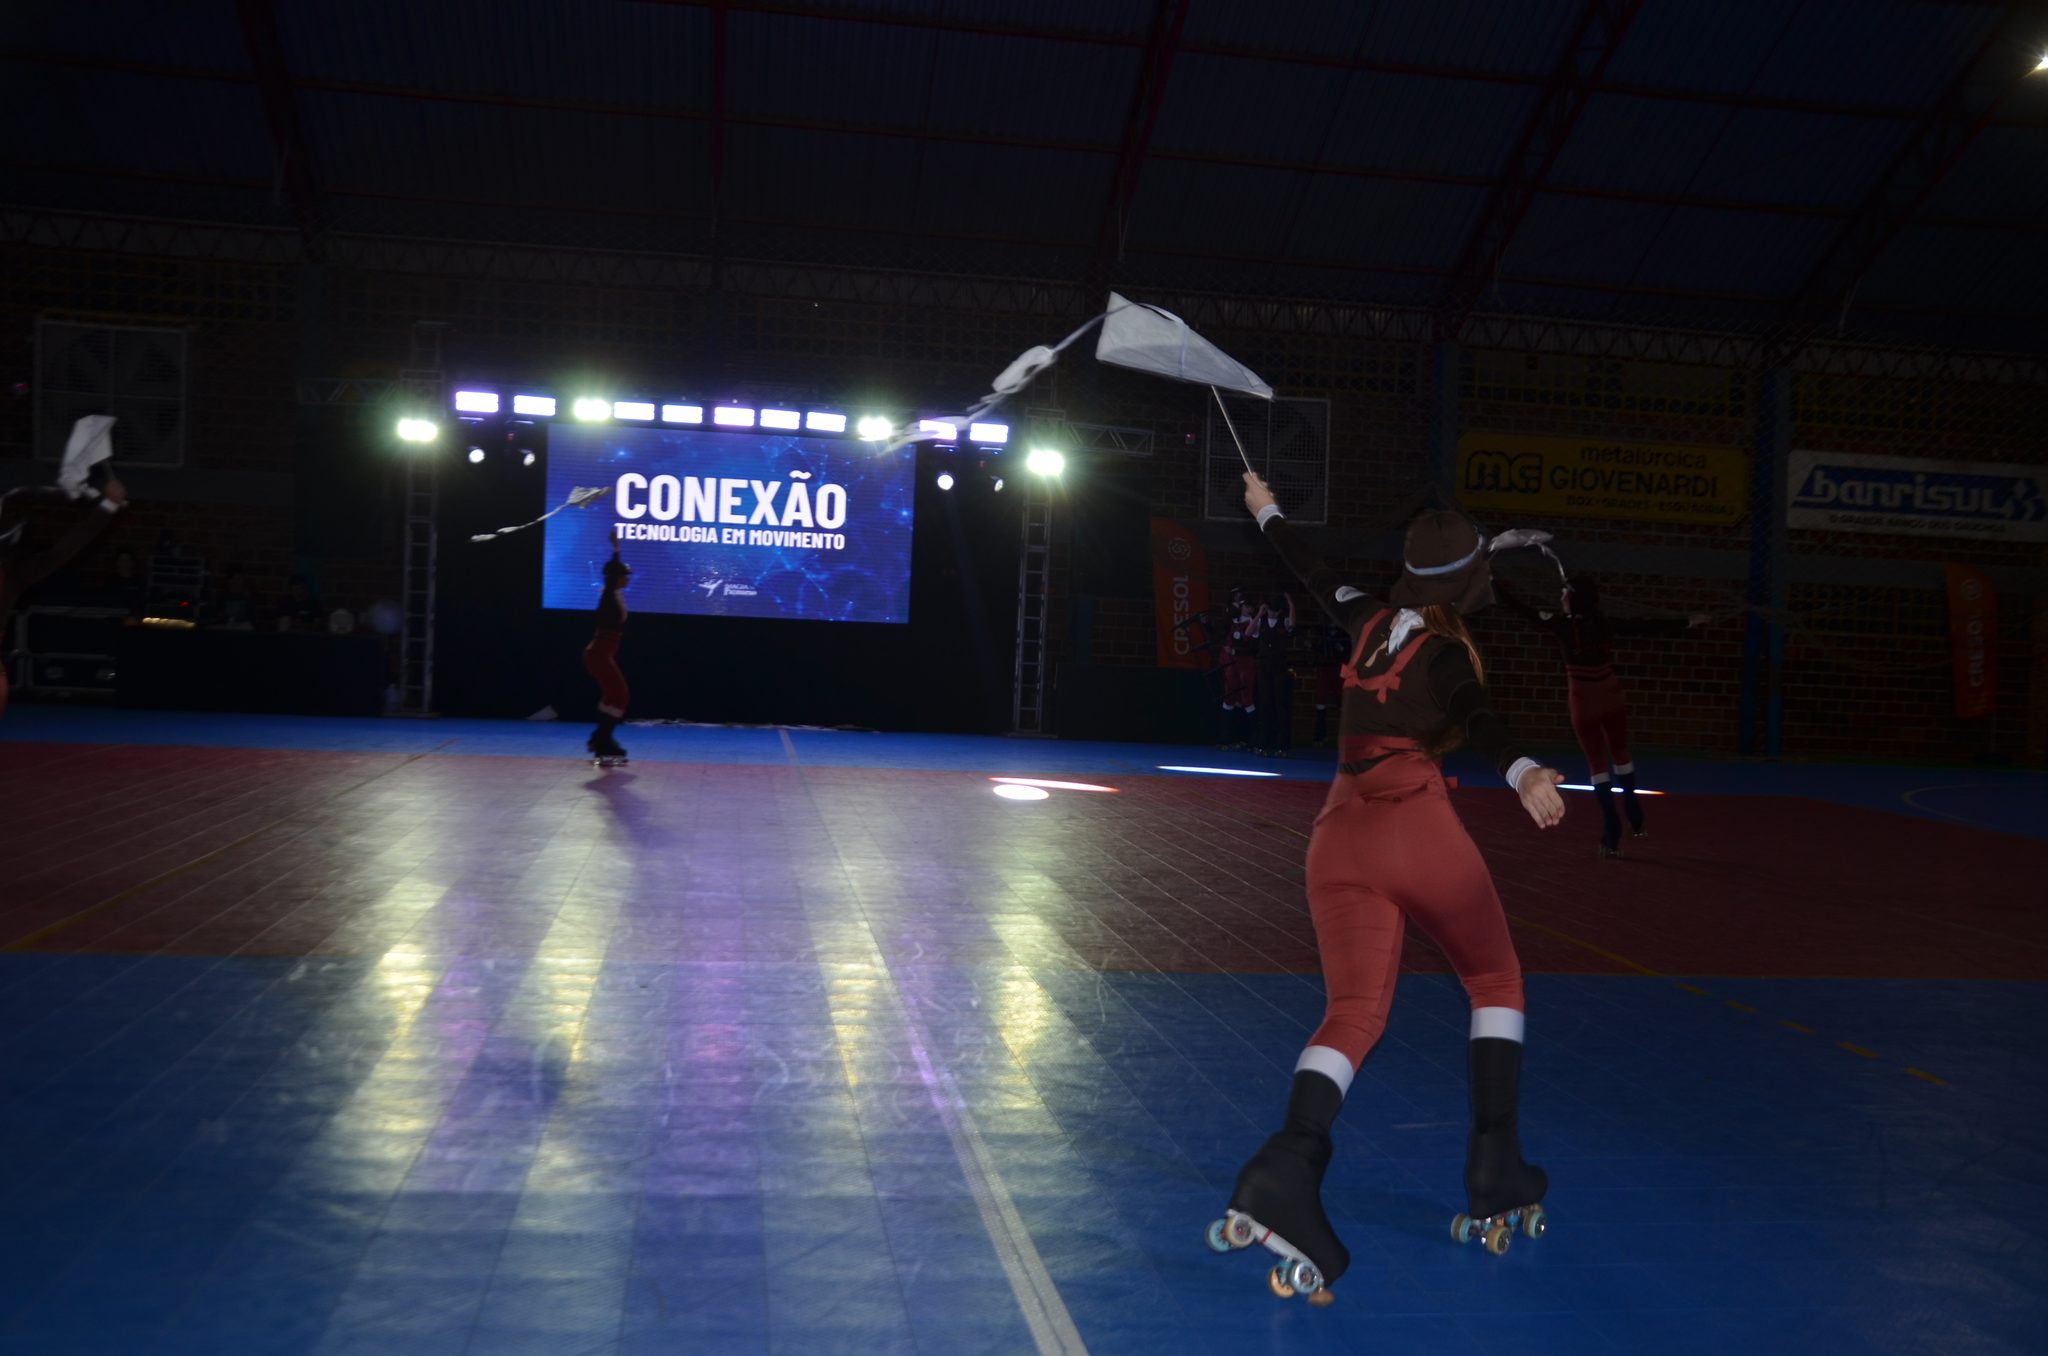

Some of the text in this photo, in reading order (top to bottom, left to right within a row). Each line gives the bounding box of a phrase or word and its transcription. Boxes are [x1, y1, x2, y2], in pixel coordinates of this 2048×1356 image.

[615, 470, 847, 529] CONEXÃO
[1549, 465, 1718, 498] GIOVENARDI
[1796, 467, 2009, 514] banrisul
[614, 523, 845, 550] TECNOLOGIA EM MOVIMENTO
[1172, 574, 1190, 656] CRESOL
